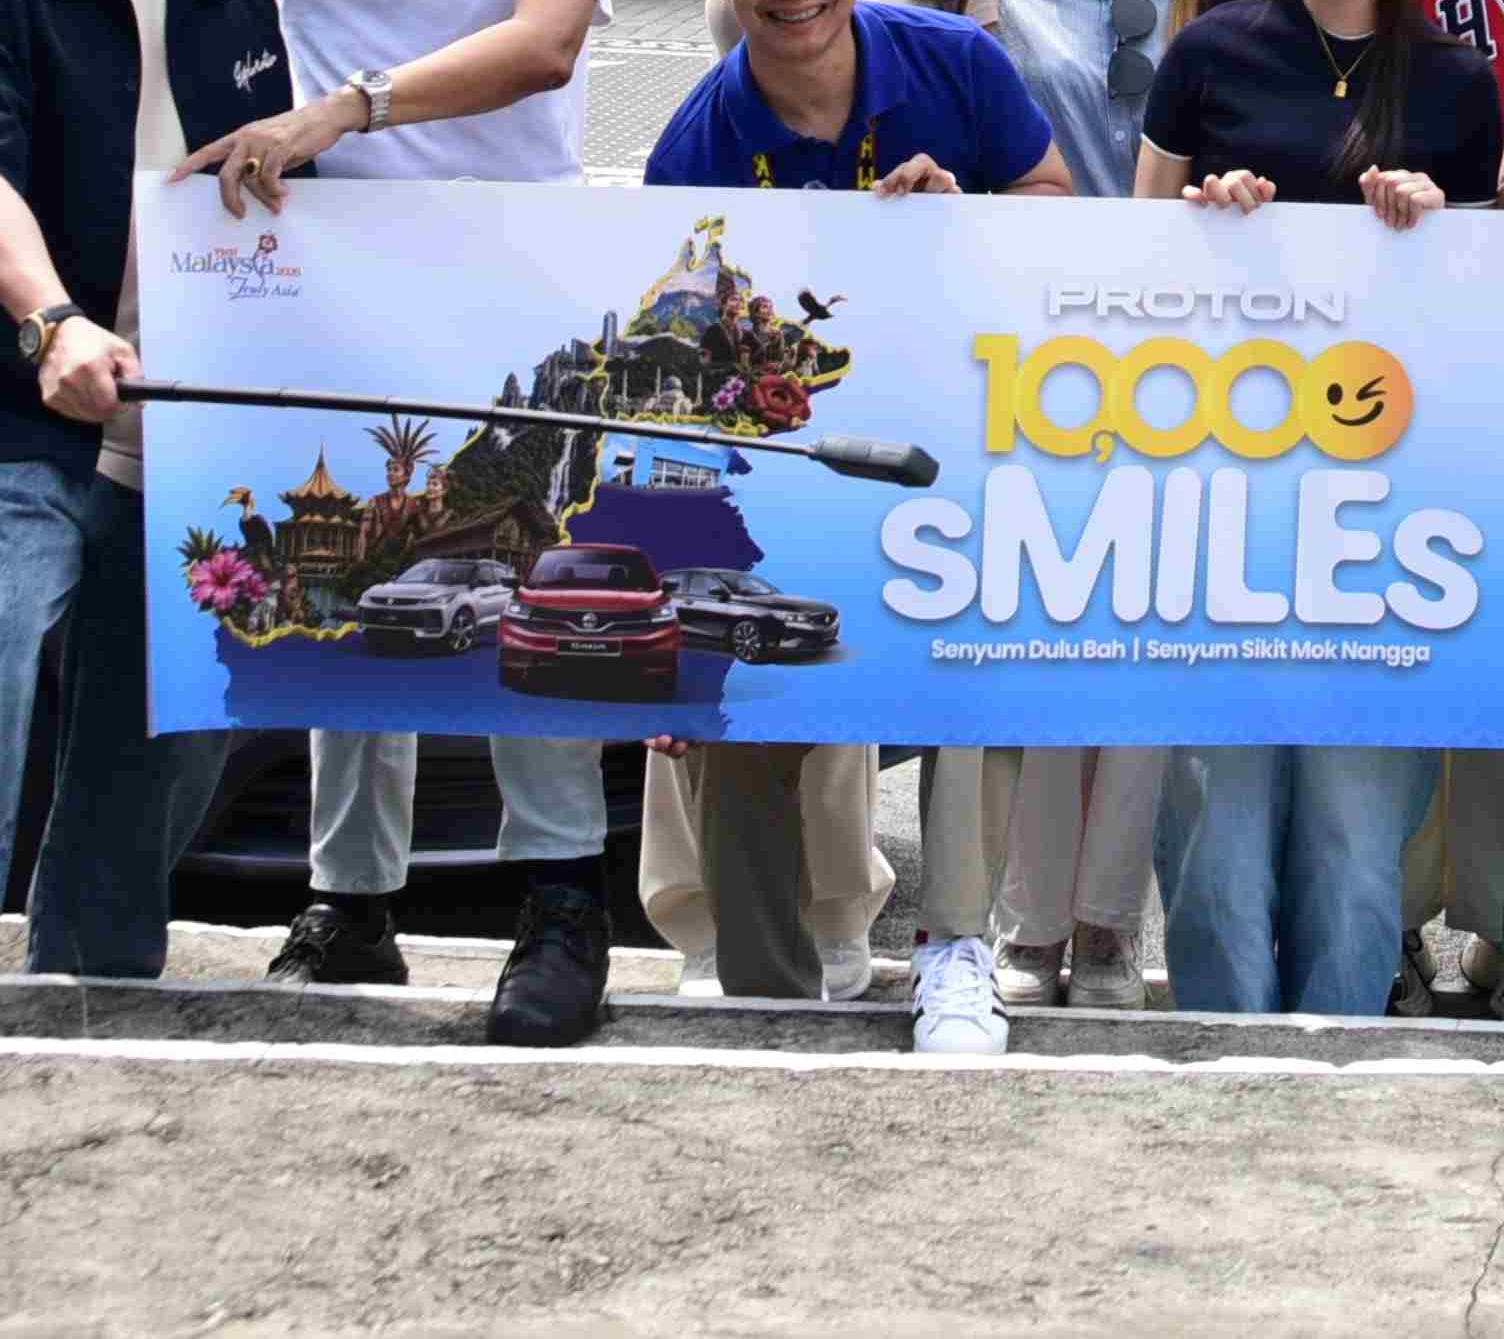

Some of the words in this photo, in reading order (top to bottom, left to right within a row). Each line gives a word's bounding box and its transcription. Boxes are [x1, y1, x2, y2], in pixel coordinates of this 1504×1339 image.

[170, 249, 274, 275] Malaysia
[1048, 283, 1345, 323] PROTON
[931, 639, 1028, 665] Senyum
[1029, 640, 1079, 659] Dulu
[1083, 640, 1126, 660] Bah
[1147, 640, 1239, 667] Senyum
[1242, 640, 1287, 660] Sikit
[1291, 641, 1337, 661] Mok
[1341, 642, 1430, 668] Nangga
